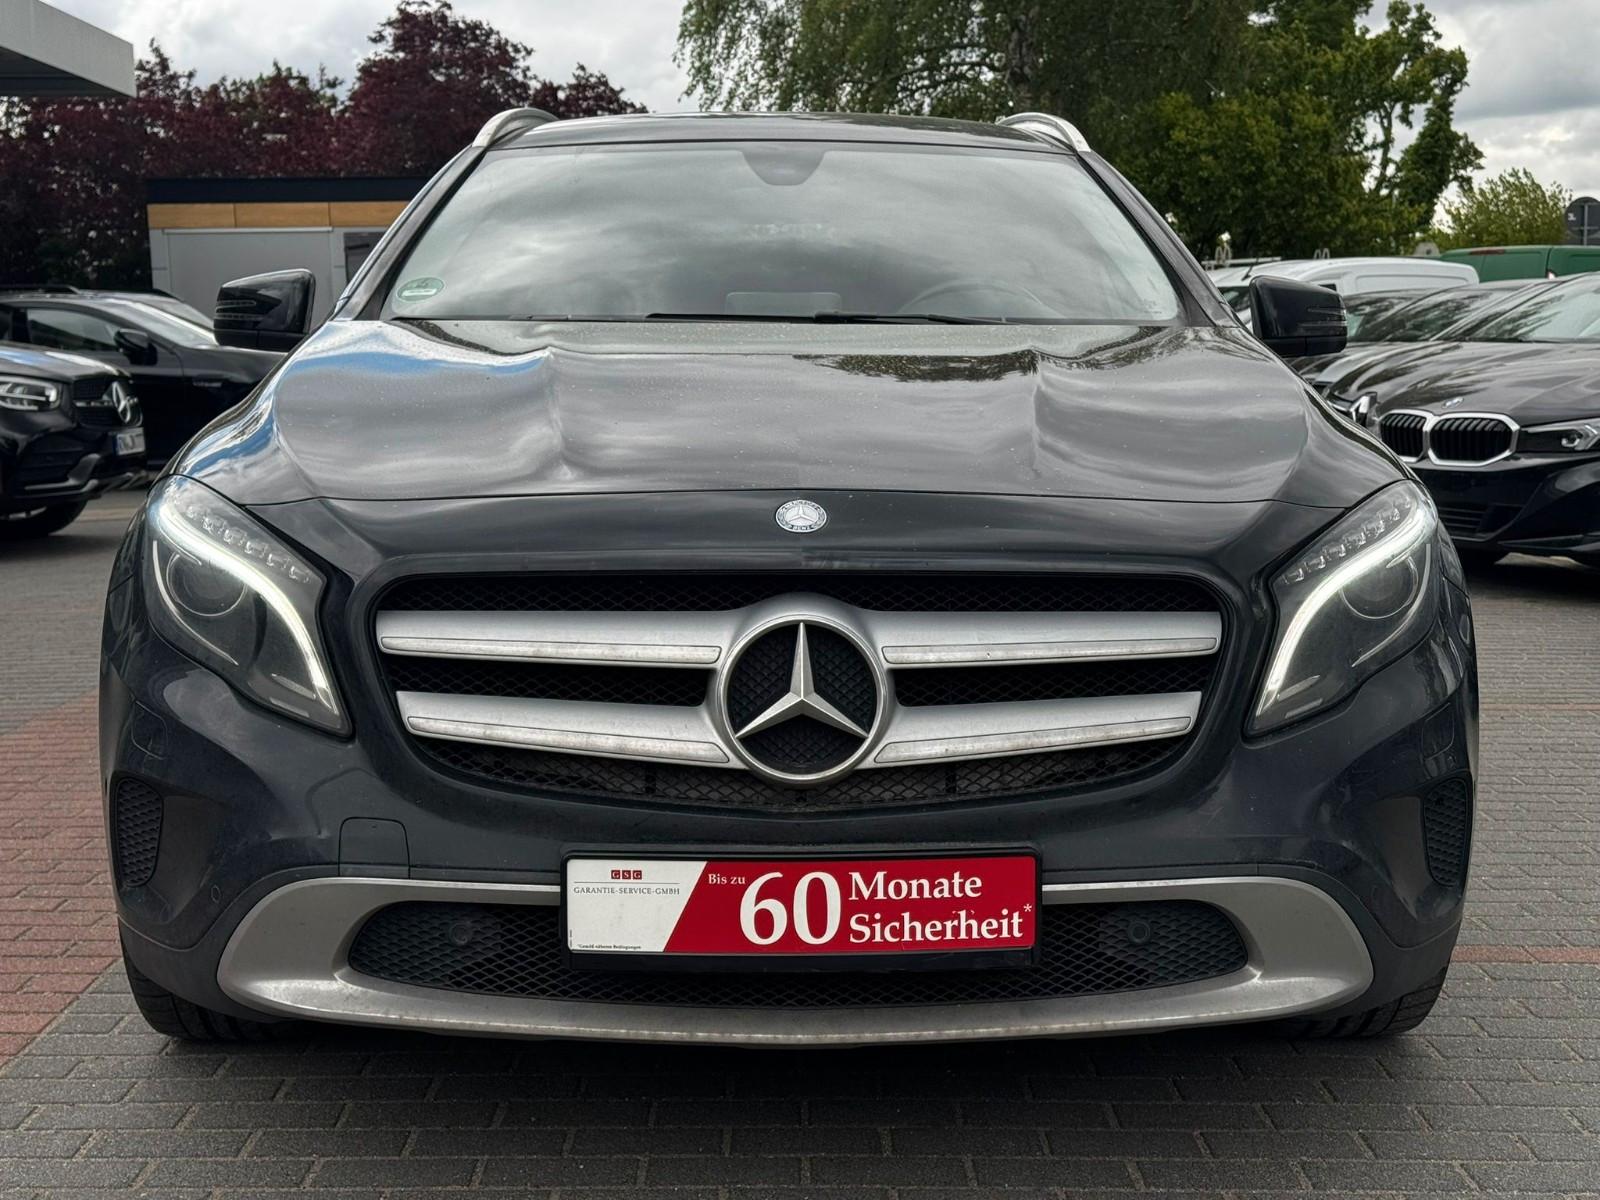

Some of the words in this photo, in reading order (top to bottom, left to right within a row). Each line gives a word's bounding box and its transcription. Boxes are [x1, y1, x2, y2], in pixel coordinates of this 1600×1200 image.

[611, 869, 642, 880] GSG
[708, 873, 727, 885] Bis
[730, 876, 746, 885] zu
[573, 887, 680, 895] GARANTIE-SERVICE-GMBH
[848, 871, 983, 900] Monate
[740, 871, 841, 945] 60
